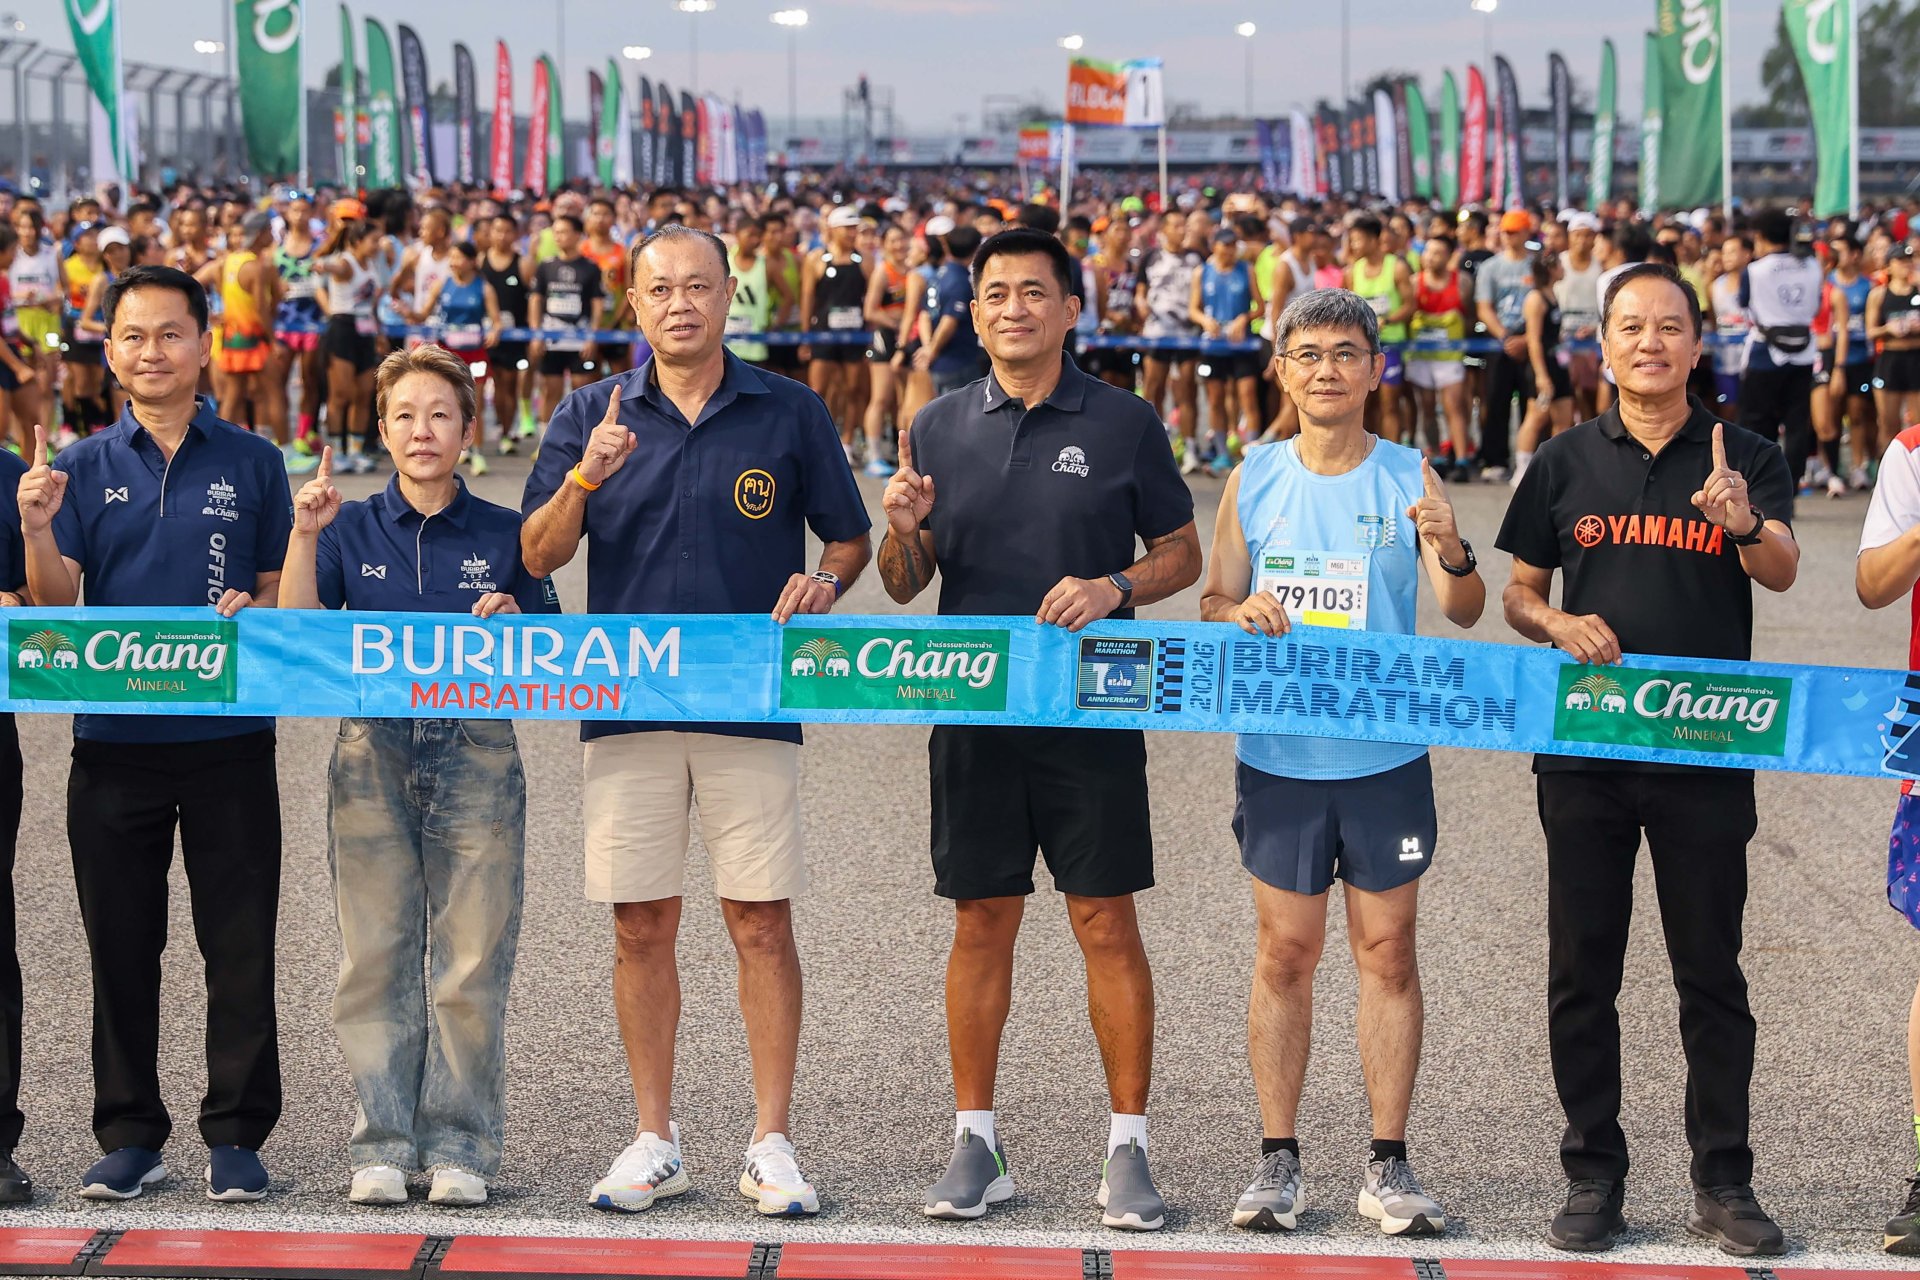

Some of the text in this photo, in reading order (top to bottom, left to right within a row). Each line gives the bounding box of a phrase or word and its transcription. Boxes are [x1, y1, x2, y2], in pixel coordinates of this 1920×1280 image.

[1051, 461, 1090, 478] Chang
[207, 490, 236, 498] BURIRAM
[208, 498, 235, 506] 2026
[214, 507, 240, 521] Chang
[1607, 514, 1724, 556] YAMAHA
[208, 533, 226, 606] OFFIC
[470, 581, 497, 591] Chang
[1276, 585, 1354, 611] 79103
[84, 630, 228, 680] Chang
[352, 623, 681, 677] BURIRAM
[1096, 641, 1138, 649] BURIRAM
[856, 637, 999, 688] Chang
[1232, 641, 1465, 690] BURIRAM
[126, 677, 187, 693] MINERAL
[1189, 640, 1215, 712] 2026
[410, 682, 620, 711] MARATHON
[896, 684, 957, 702] MINERAL
[1086, 696, 1140, 704] ANNIVERSARY
[1229, 680, 1516, 732] MARATHON
[1633, 679, 1780, 733] Chang
[1673, 726, 1735, 743] MINERAL
